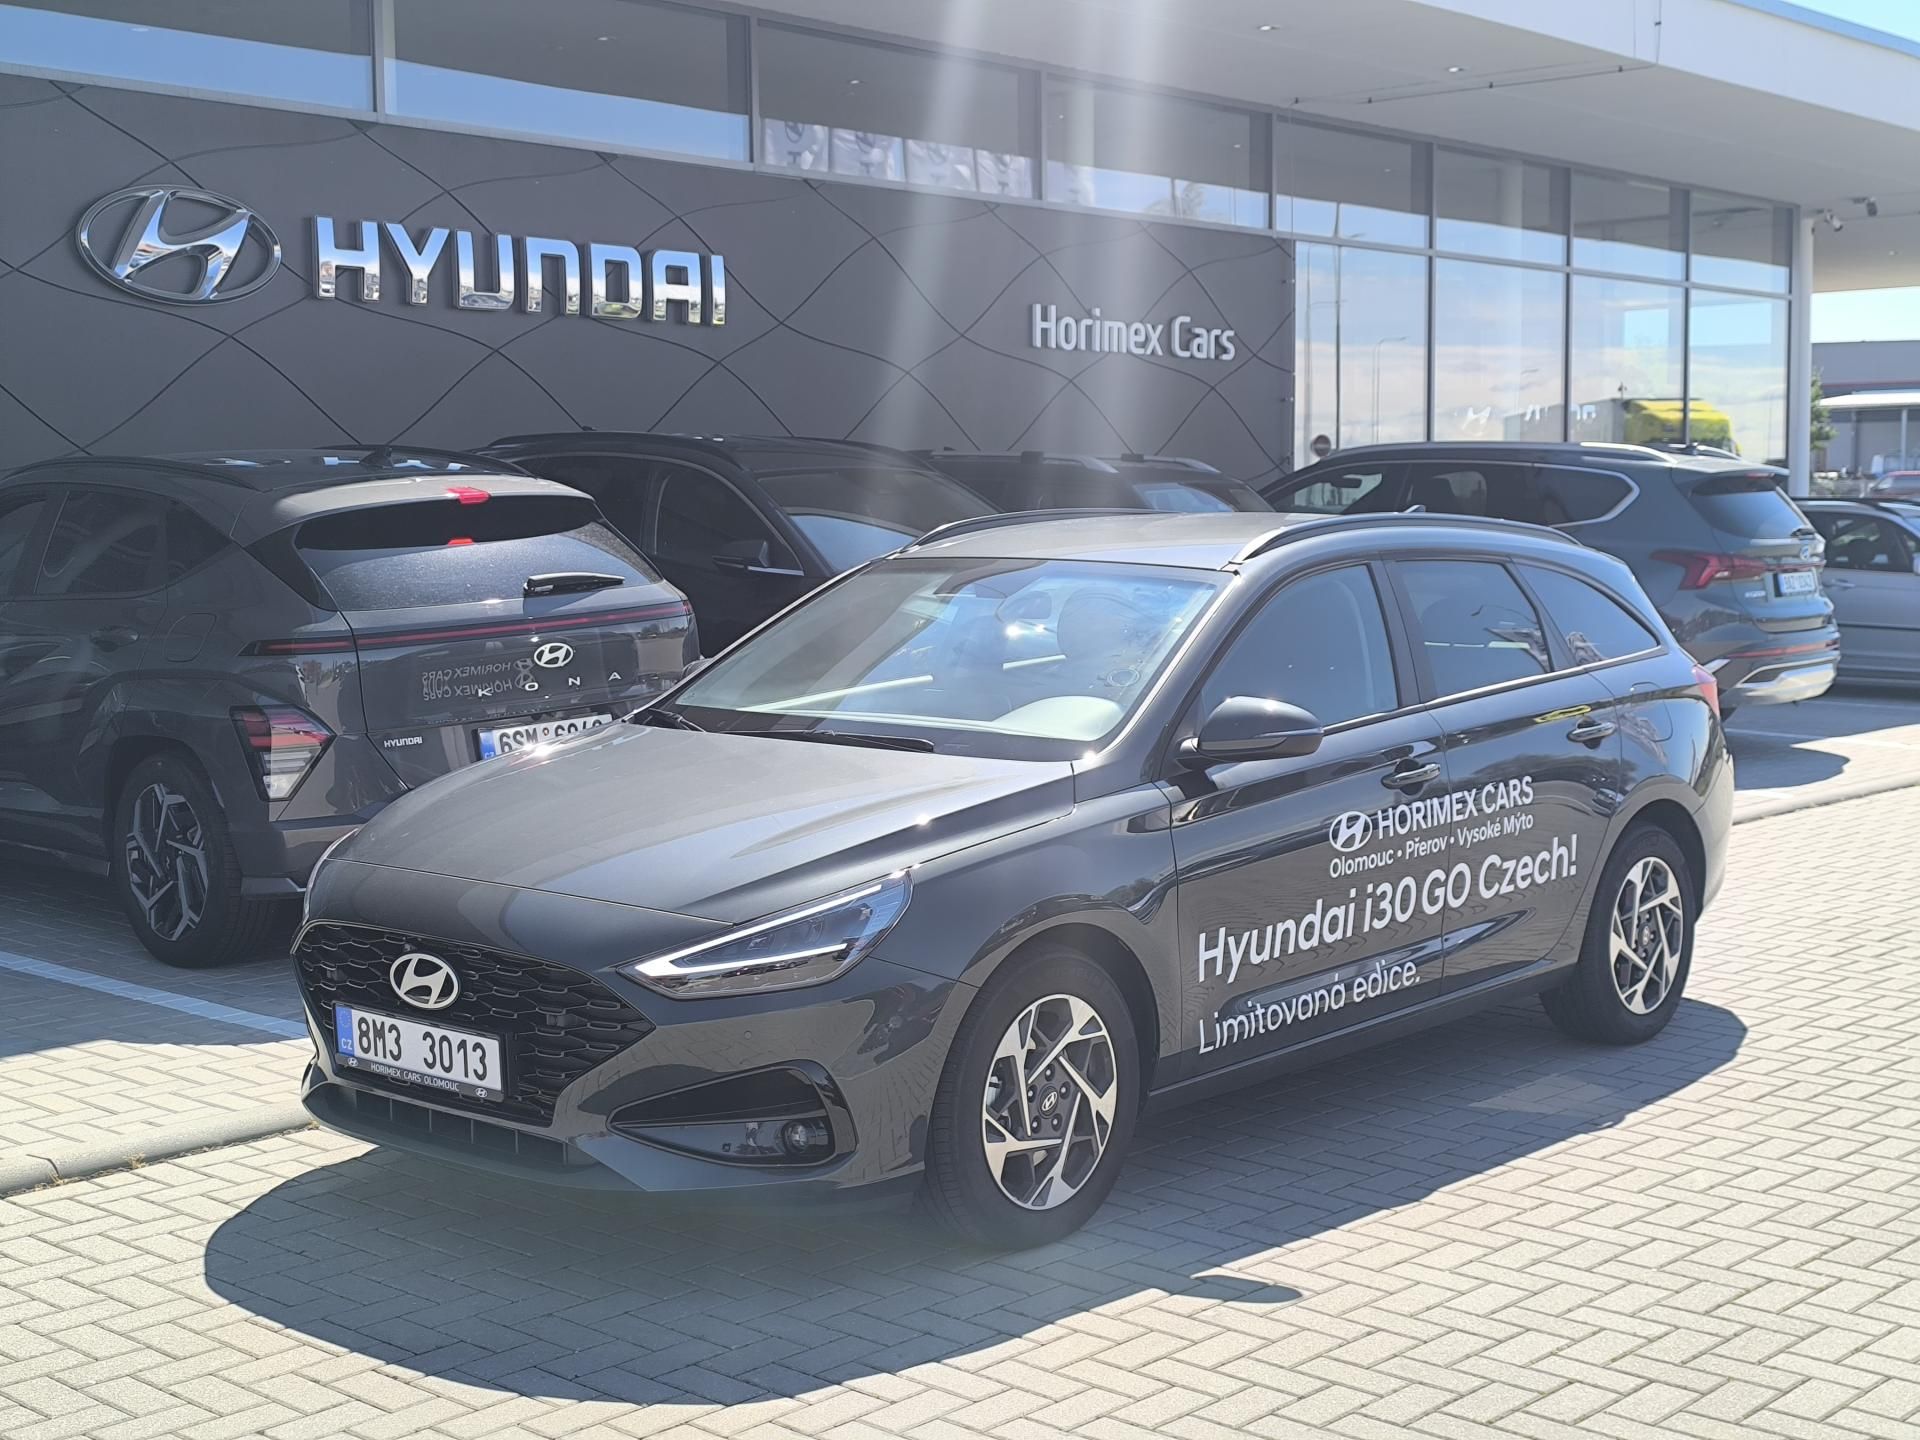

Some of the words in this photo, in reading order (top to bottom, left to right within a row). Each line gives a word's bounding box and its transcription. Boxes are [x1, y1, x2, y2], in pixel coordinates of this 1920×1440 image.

[312, 215, 726, 325] HYUNDAI
[1030, 303, 1164, 356] Horimex
[1171, 316, 1236, 361] Cars
[477, 671, 622, 698] KONA
[384, 736, 423, 748] HYUNDAI
[1377, 788, 1478, 840] HORIMEX
[1481, 775, 1534, 815] CARS
[1329, 848, 1394, 879] Olomouc
[1405, 835, 1449, 861] Přerov
[1457, 819, 1502, 849] Vysoké
[1503, 812, 1534, 840] Mýto
[1198, 888, 1357, 984] Hyundai
[1363, 876, 1417, 933] i30
[1421, 862, 1472, 916] GO
[1478, 833, 1578, 899] Czech!
[1198, 973, 1346, 1055] Limitovaná
[1353, 959, 1421, 1003] edice.
[341, 1039, 353, 1050] CZ
[357, 1016, 402, 1062] 8M3
[422, 1031, 488, 1082] 3013
[370, 1063, 401, 1080] HORIMEX
[403, 1071, 422, 1084] CARS
[423, 1077, 460, 1092] OLOMOUC
